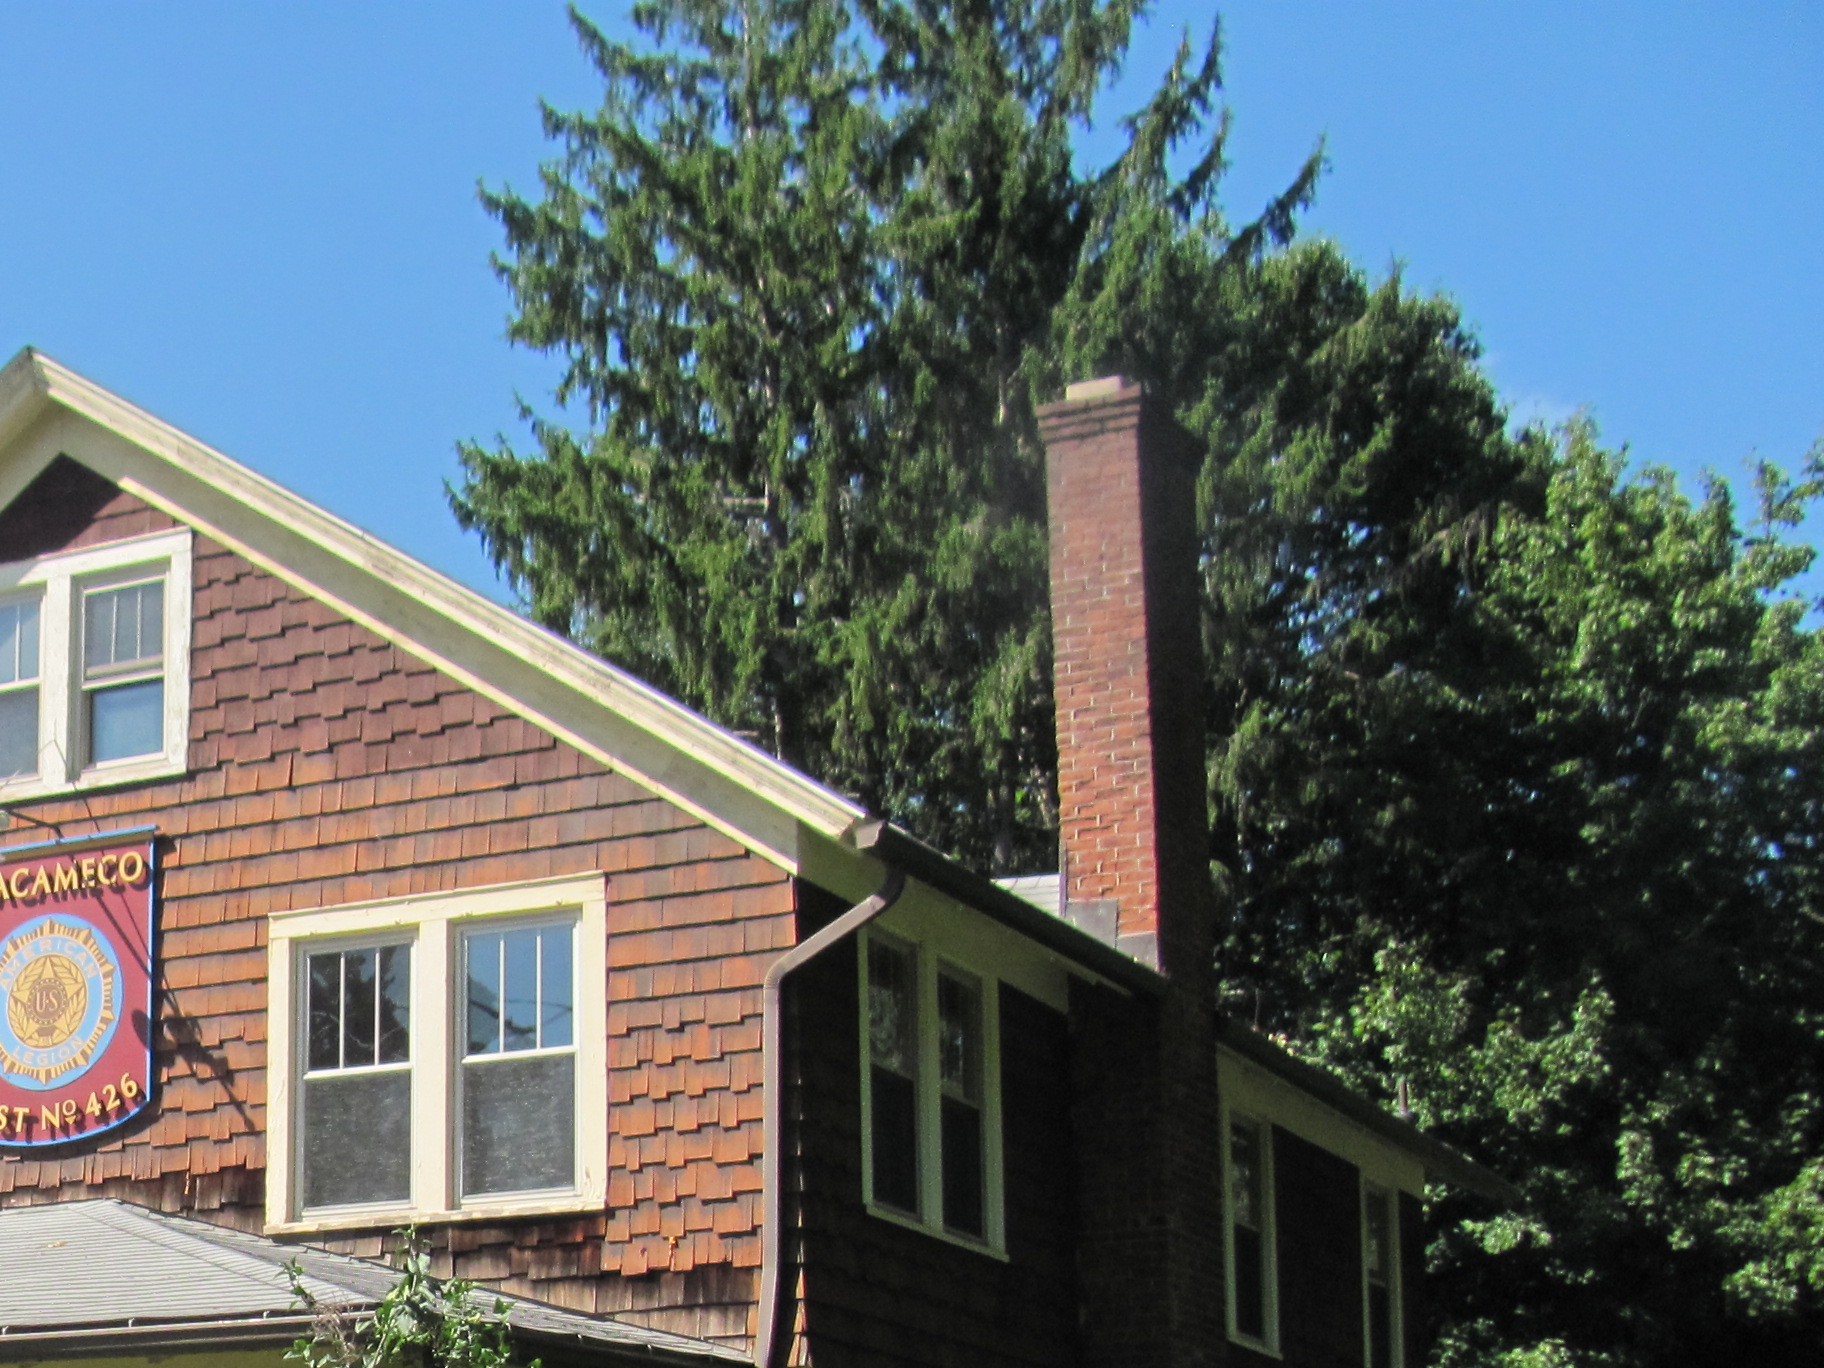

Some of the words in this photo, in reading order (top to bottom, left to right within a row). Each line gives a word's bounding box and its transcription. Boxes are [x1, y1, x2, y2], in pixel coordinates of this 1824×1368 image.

[0, 938, 98, 992] AMERICAN
[12, 1036, 86, 1067] LEGION
[85, 1072, 138, 1117] 426
